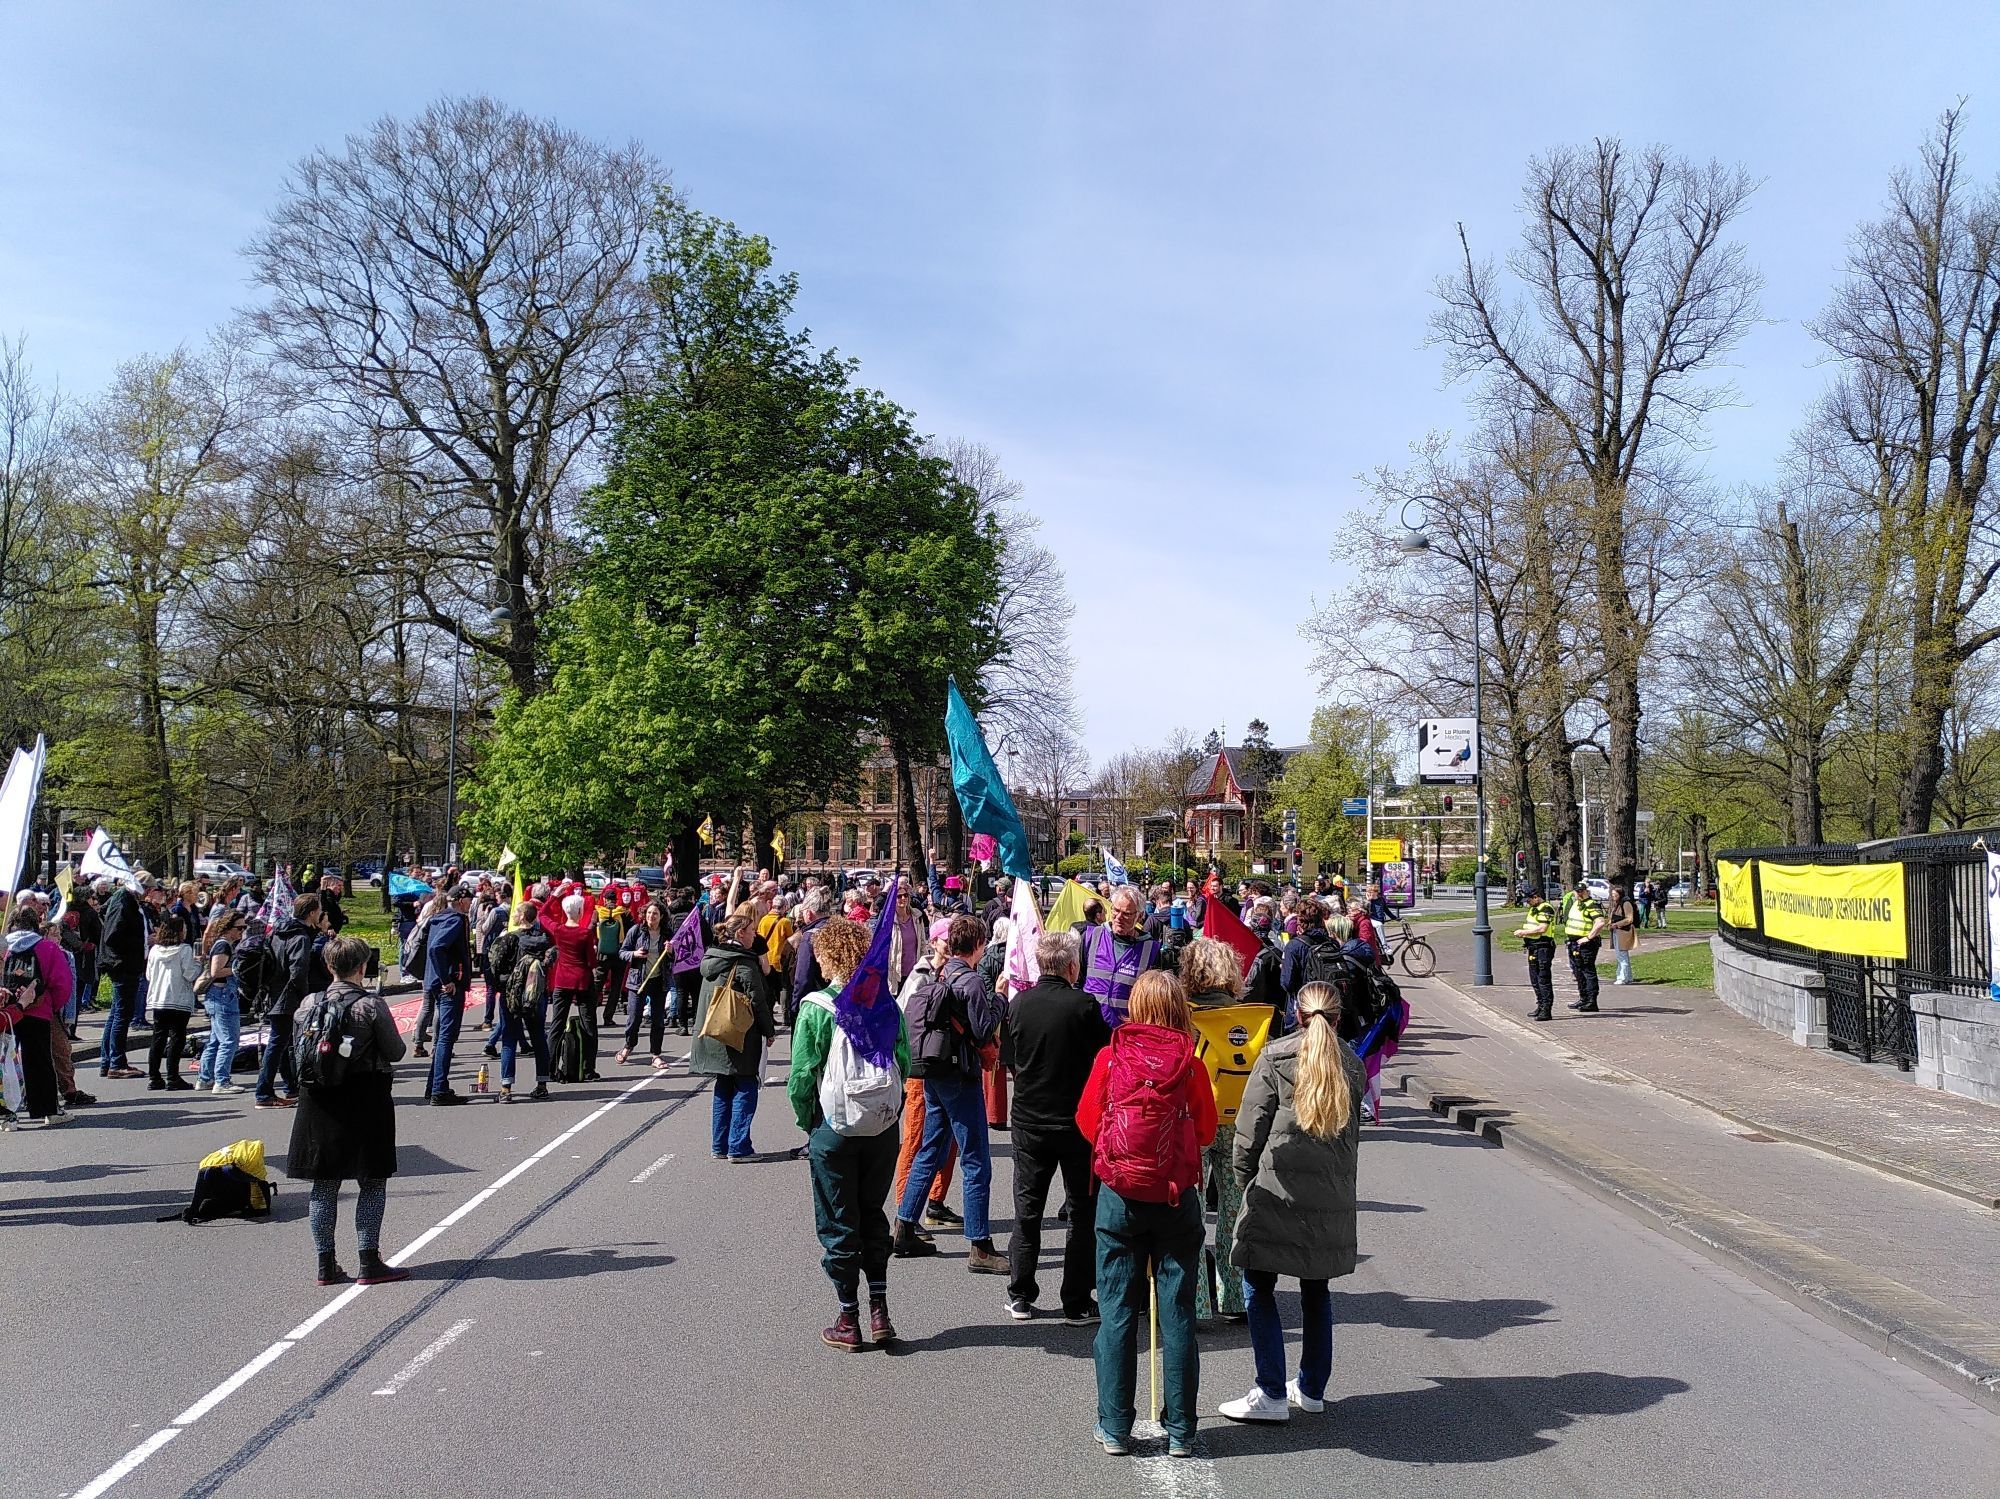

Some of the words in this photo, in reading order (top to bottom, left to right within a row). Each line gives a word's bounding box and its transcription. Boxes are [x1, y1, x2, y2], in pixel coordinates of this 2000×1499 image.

[1764, 889, 1777, 910] GEEN
[1776, 891, 1815, 918] VERGUNNING
[1815, 895, 1834, 919] VOOR
[1834, 897, 1892, 922] VERVUILING
